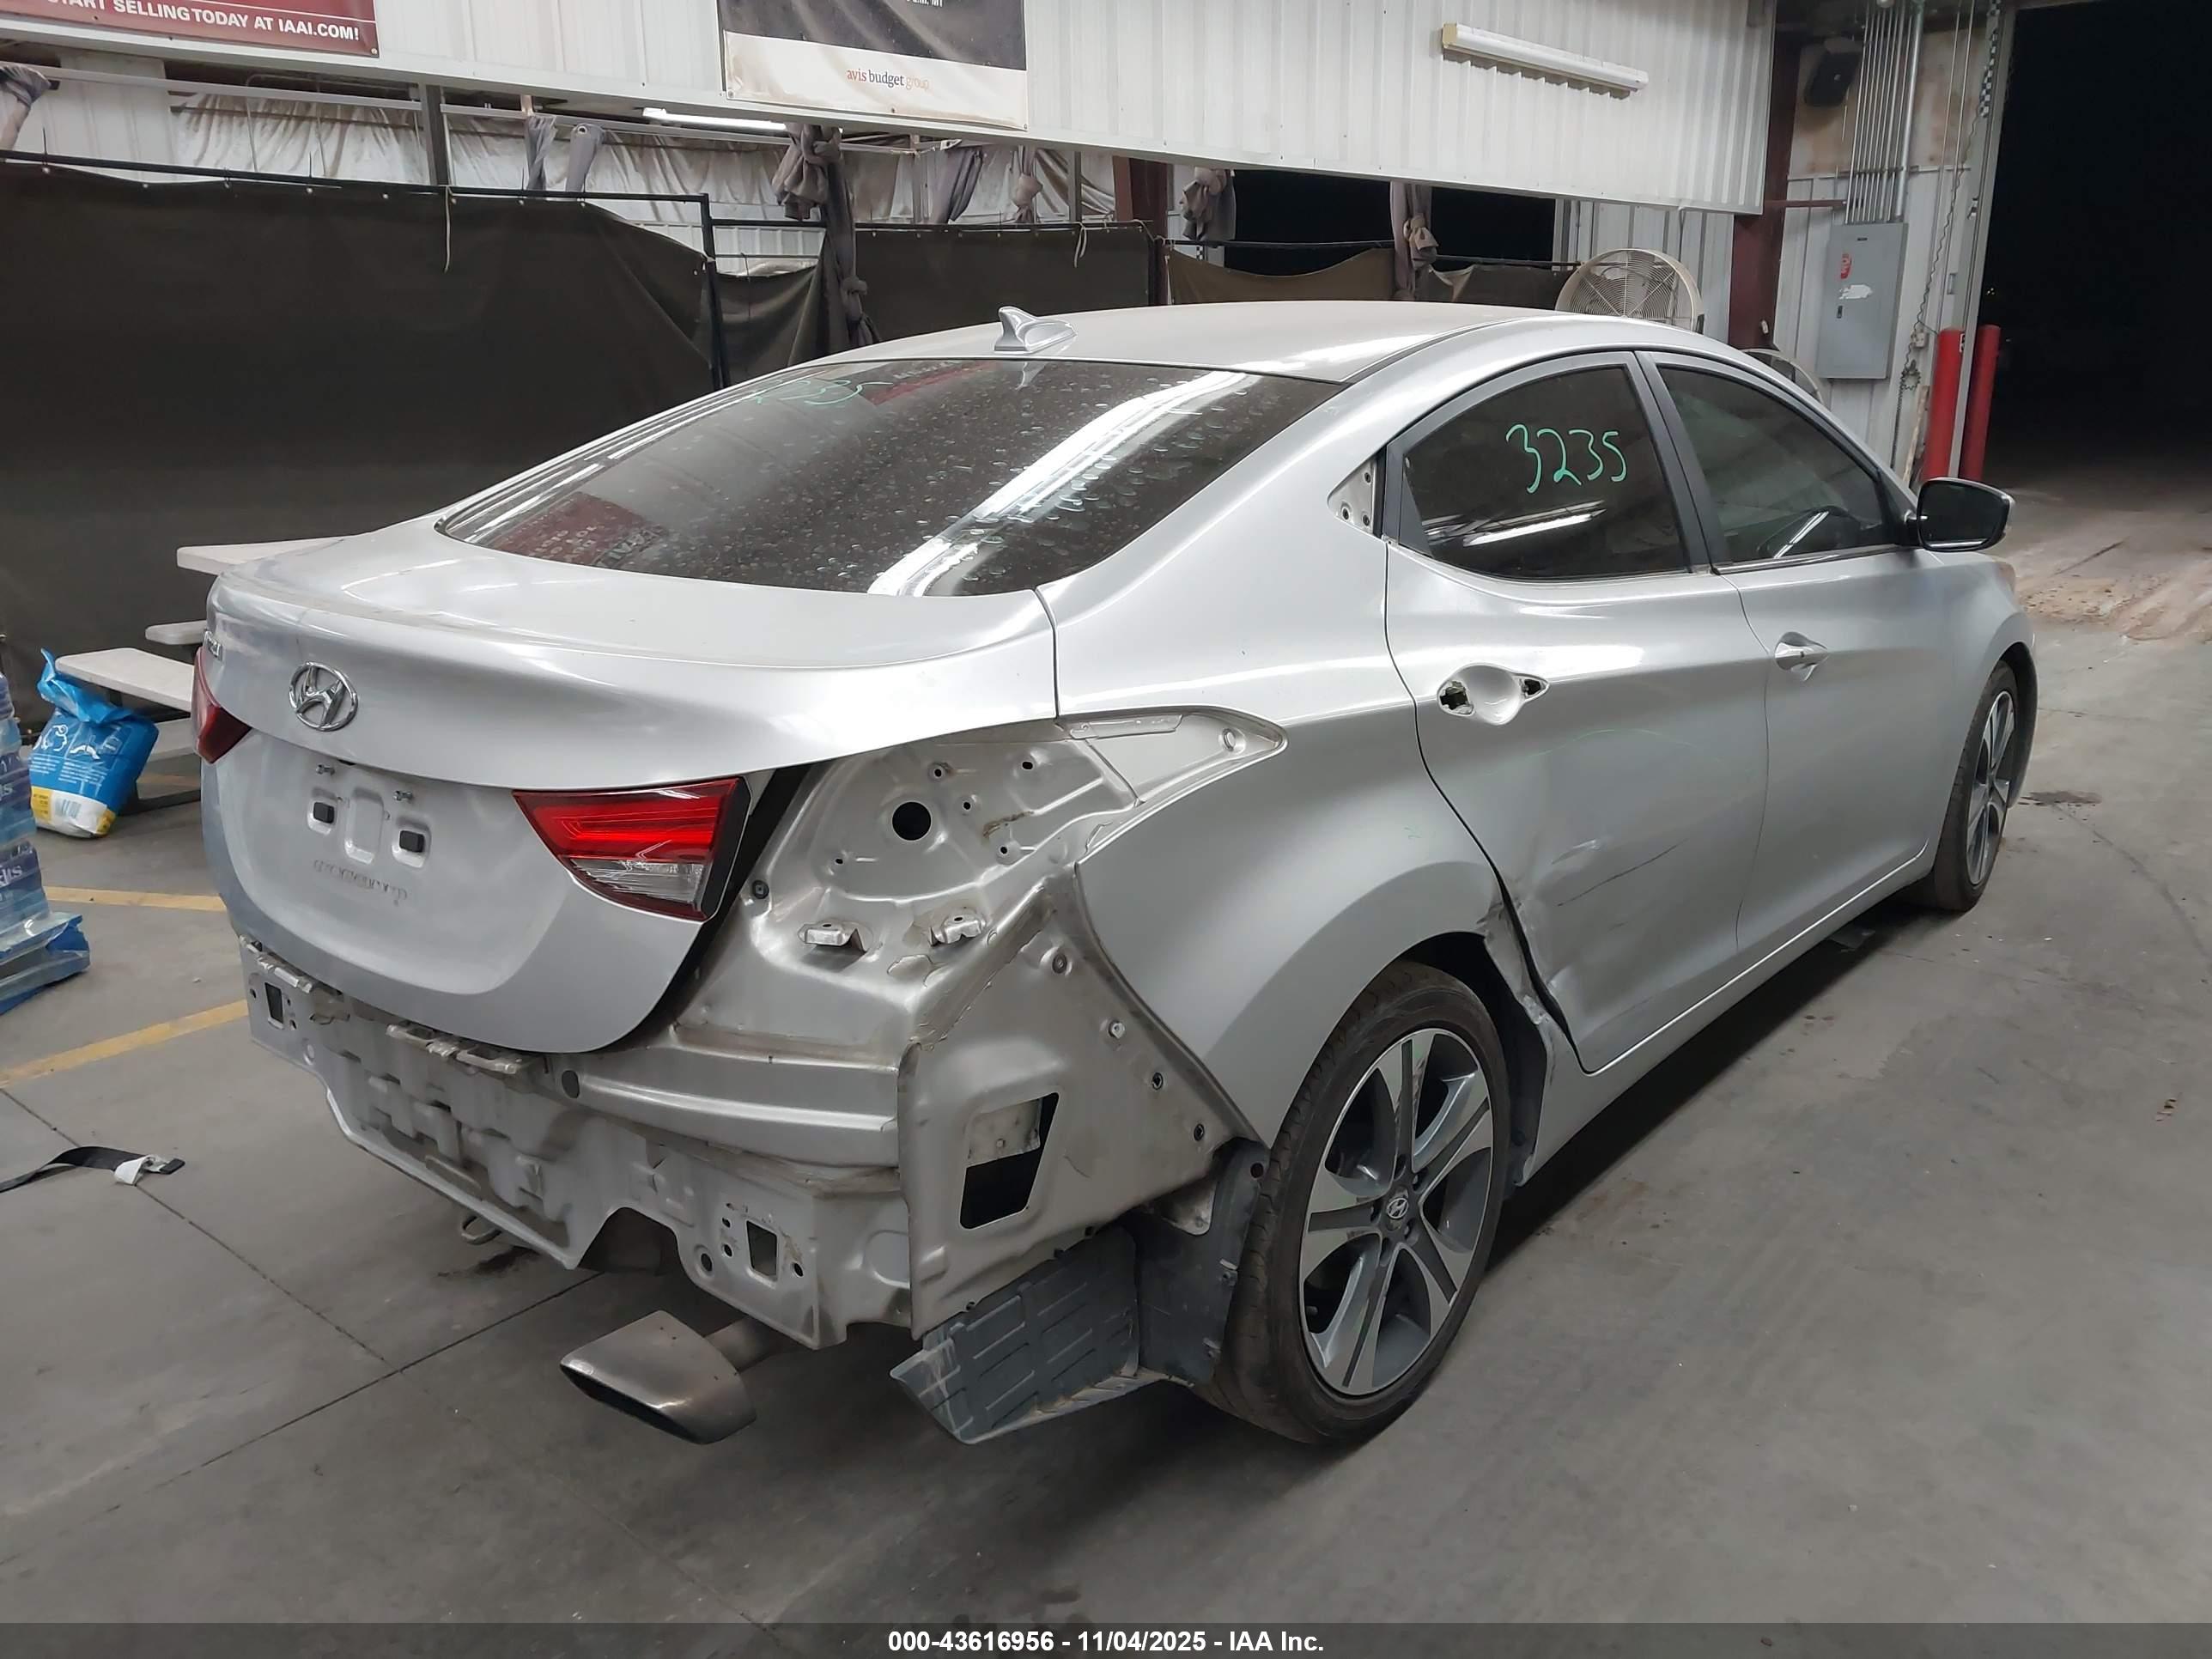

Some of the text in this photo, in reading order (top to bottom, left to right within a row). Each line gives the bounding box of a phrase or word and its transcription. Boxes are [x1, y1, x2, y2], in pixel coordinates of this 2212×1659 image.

[113, 0, 191, 21] SELLING
[191, 9, 249, 28] TODAY
[254, 16, 274, 31] AT
[278, 18, 360, 40] IAAI.COM!
[847, 68, 867, 82] avis
[868, 70, 904, 88] budget
[1505, 423, 1627, 494] 3235
